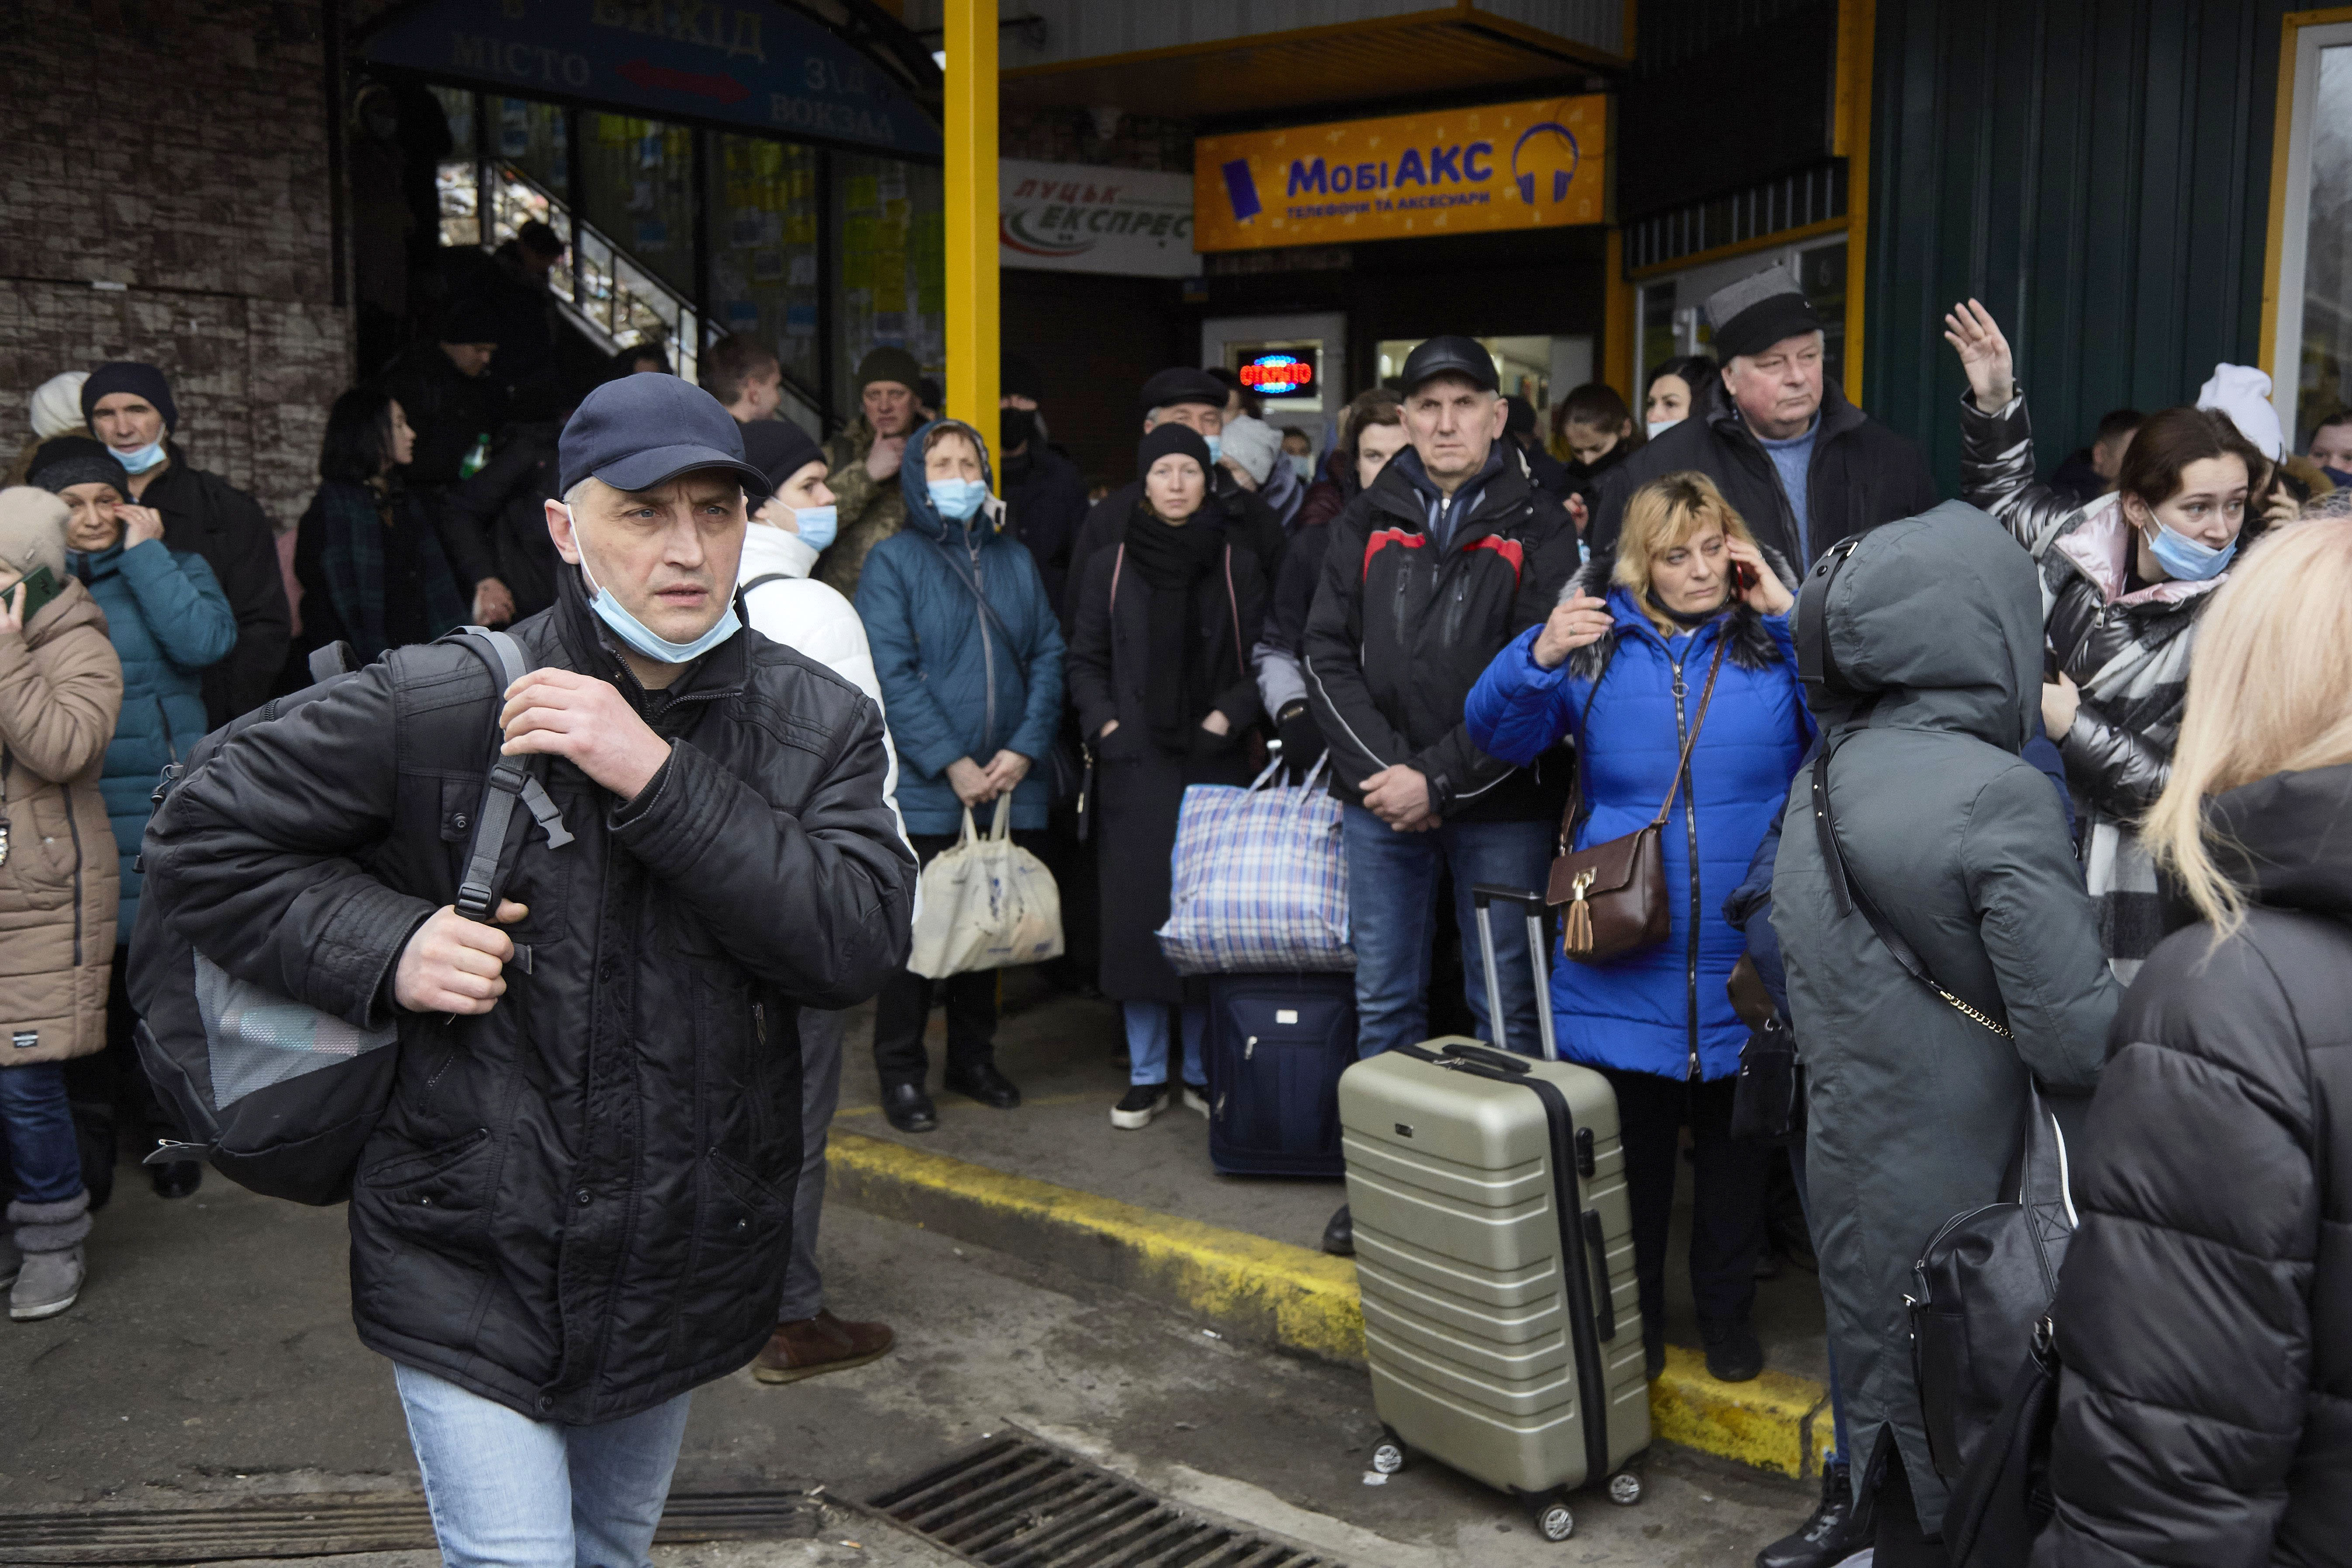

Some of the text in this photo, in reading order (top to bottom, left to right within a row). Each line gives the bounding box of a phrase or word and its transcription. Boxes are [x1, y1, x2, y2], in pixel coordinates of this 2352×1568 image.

[451, 31, 591, 87] МІСТО
[770, 93, 896, 143] ВОКЗАЛ
[1012, 178, 1121, 204] ЛУЦЬК
[1287, 190, 1490, 219] ТЕЛЕФОНИ ТА АКСЕСУАРИ
